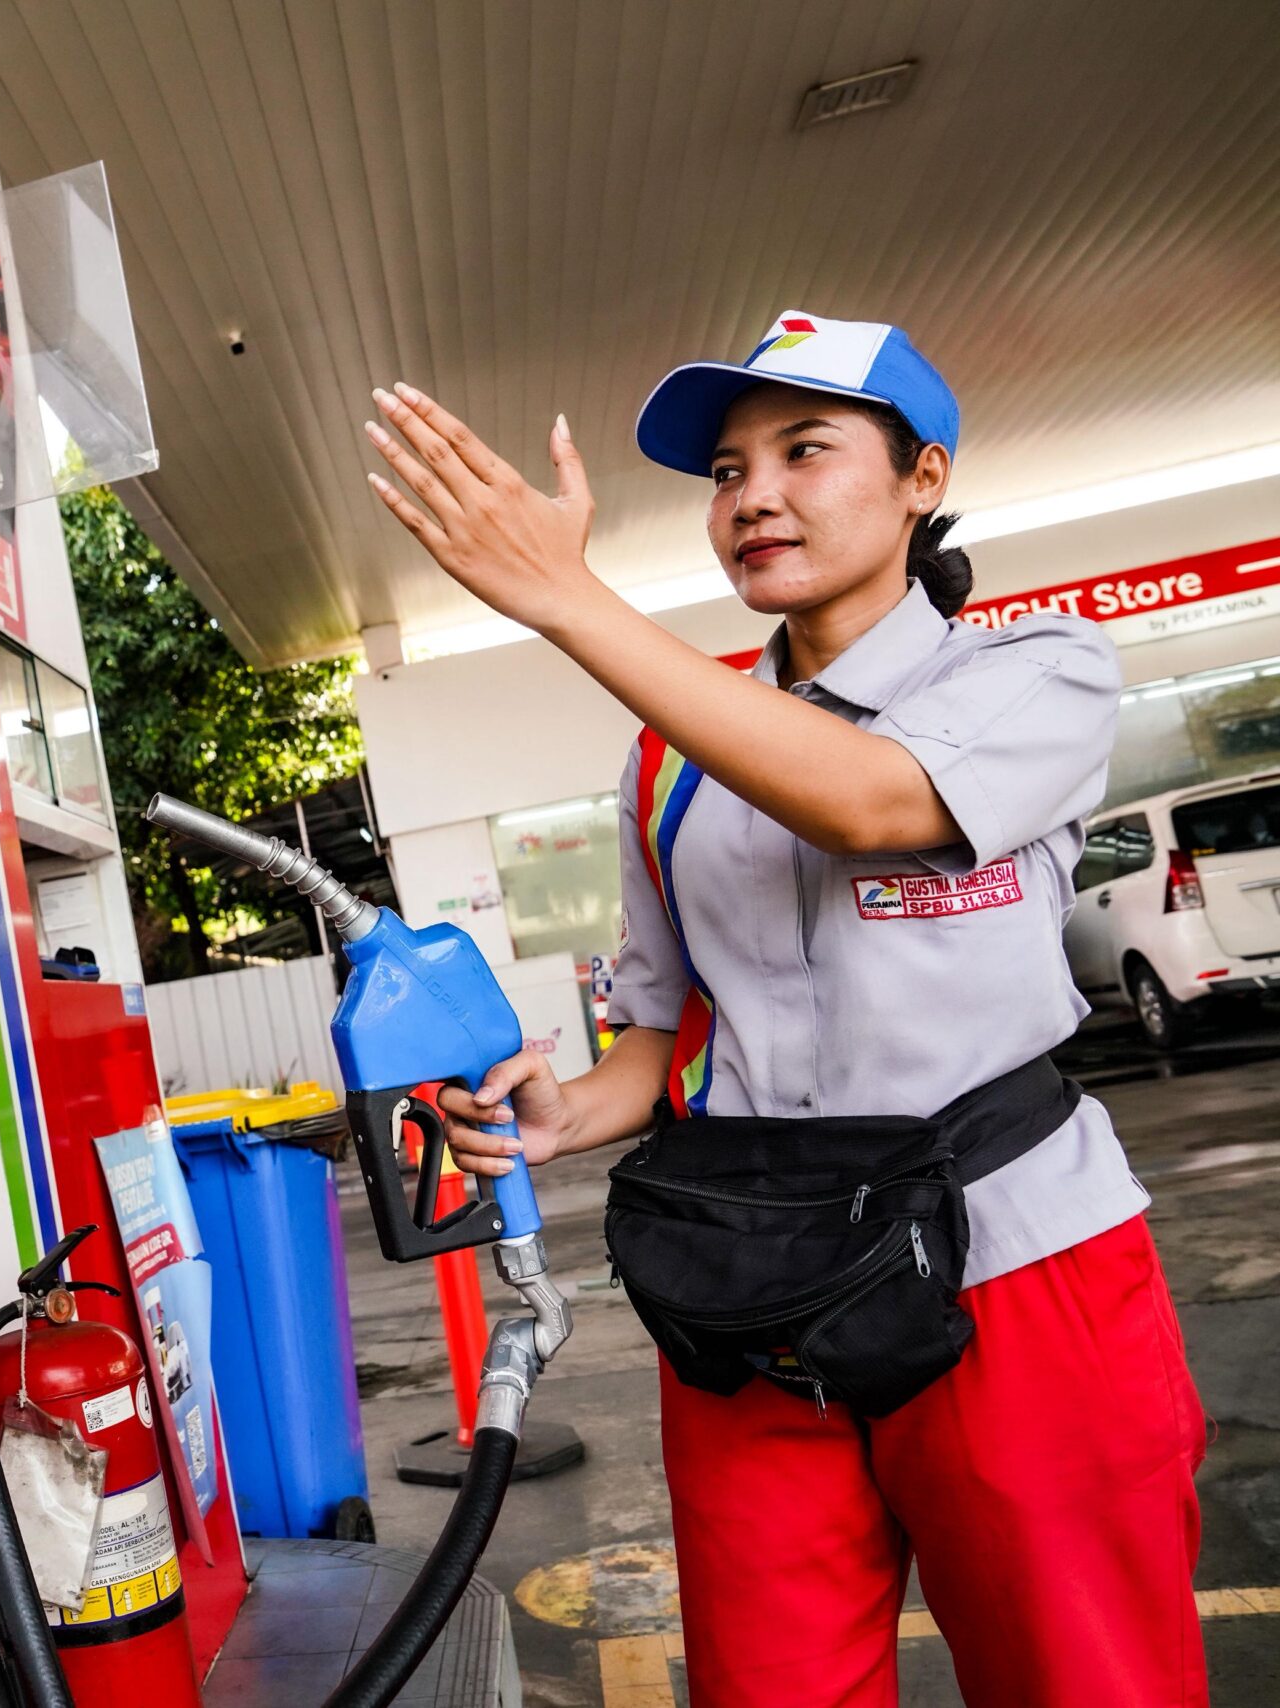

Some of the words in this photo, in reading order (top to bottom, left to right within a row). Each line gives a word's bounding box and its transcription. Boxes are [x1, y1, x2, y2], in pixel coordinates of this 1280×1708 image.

[963, 588, 1084, 632] RIGHT
[1092, 572, 1204, 615] Store
[1149, 619, 1167, 632] by
[1172, 596, 1267, 624] PERTAMINA
[906, 876, 952, 897] GUSTINA
[955, 865, 1014, 890] AGNESTASIA
[861, 900, 903, 909] PERTAMINA
[909, 899, 954, 914] SPBU
[961, 886, 1020, 908] 31.126.01
[863, 909, 888, 917] RETAIL
[124, 1537, 144, 1548] SERBUK
[91, 1578, 108, 1587] CARA
[108, 1564, 151, 1583] MENGGUNAKAN
